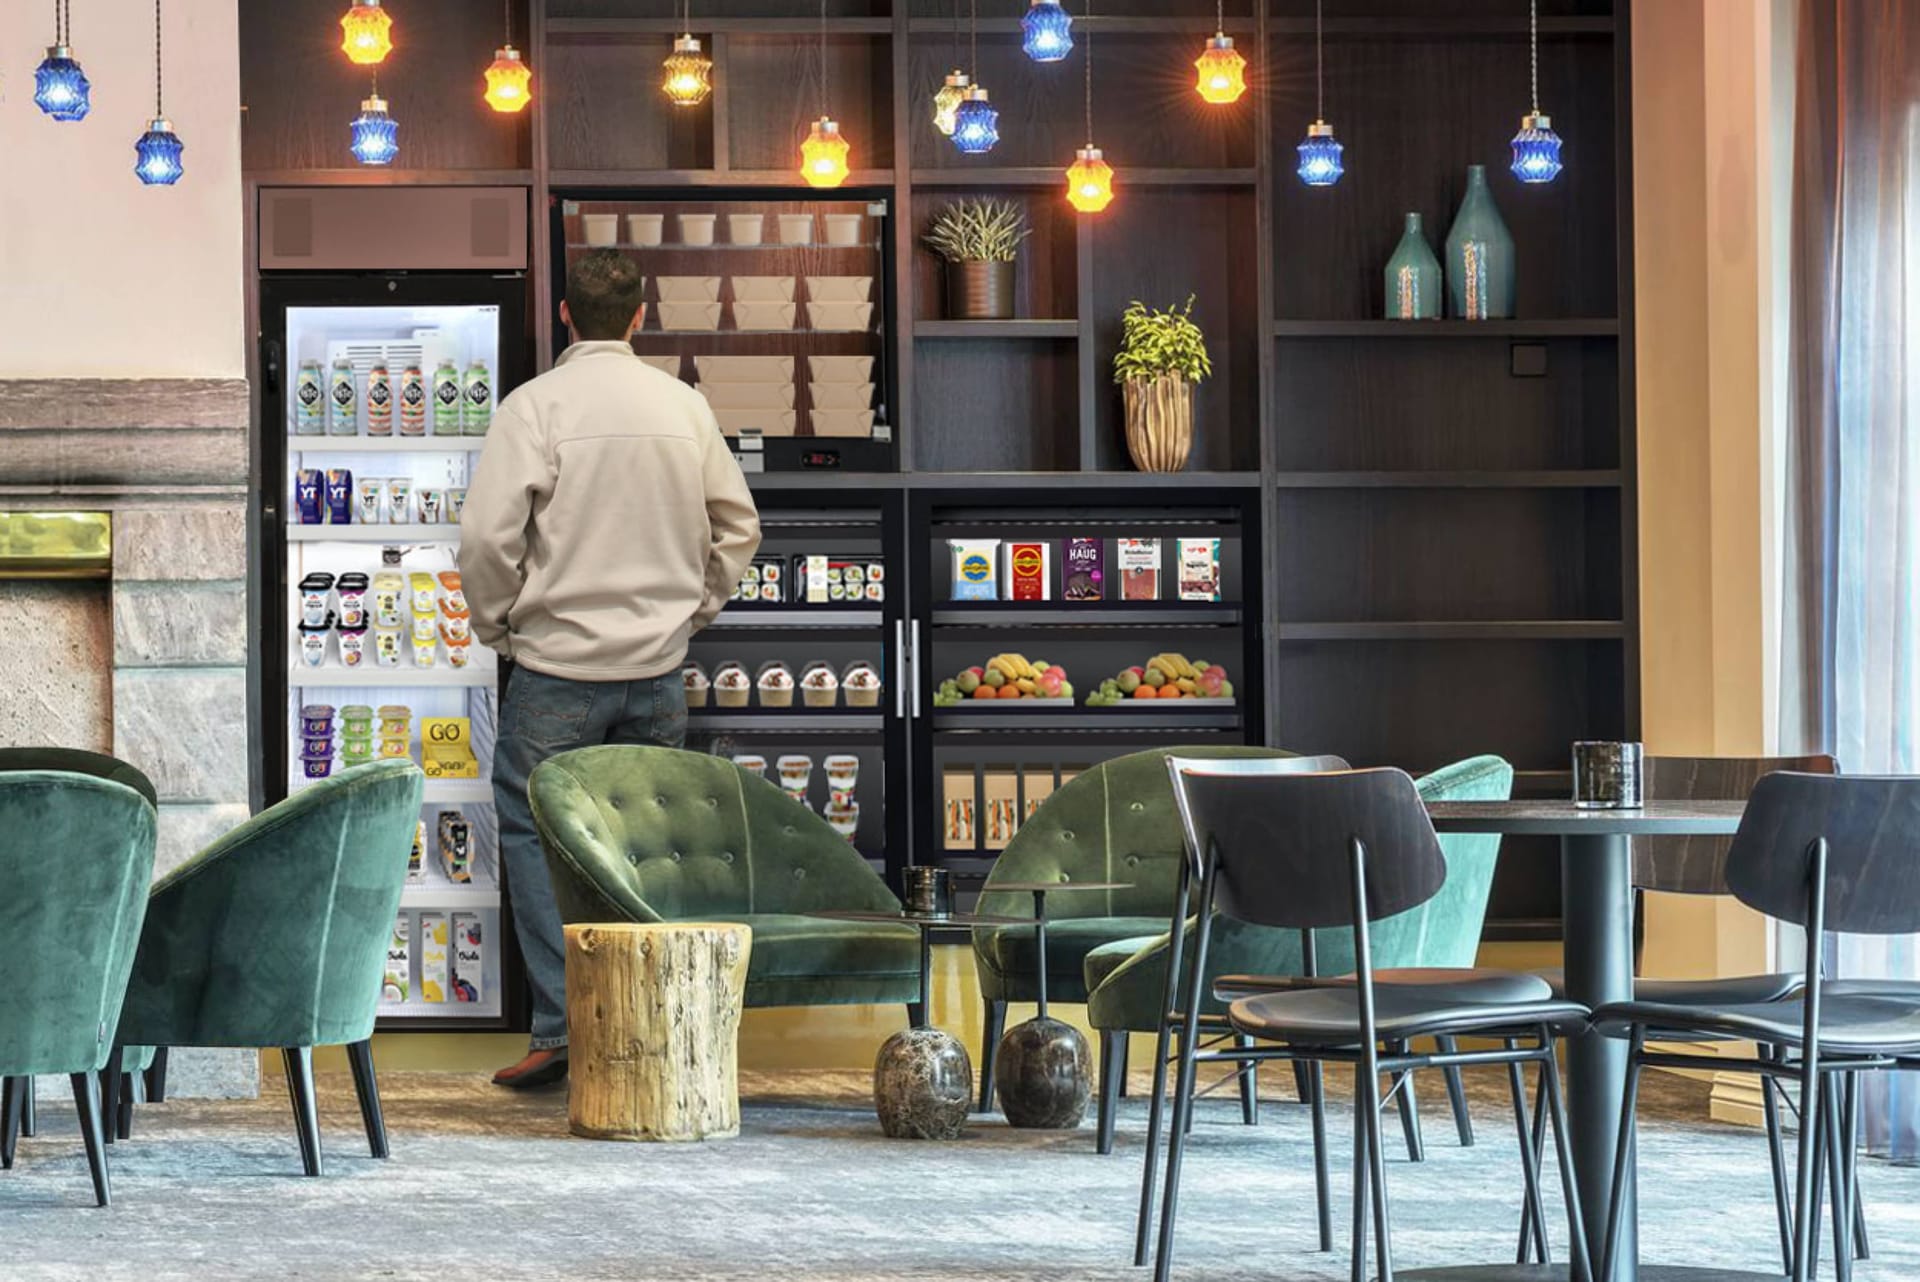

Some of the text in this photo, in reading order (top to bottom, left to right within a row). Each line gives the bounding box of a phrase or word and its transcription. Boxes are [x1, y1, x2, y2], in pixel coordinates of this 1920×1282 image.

[300, 487, 317, 499] YT
[330, 487, 346, 499] YT
[1069, 548, 1097, 561] HAUG
[429, 723, 460, 741] GO
